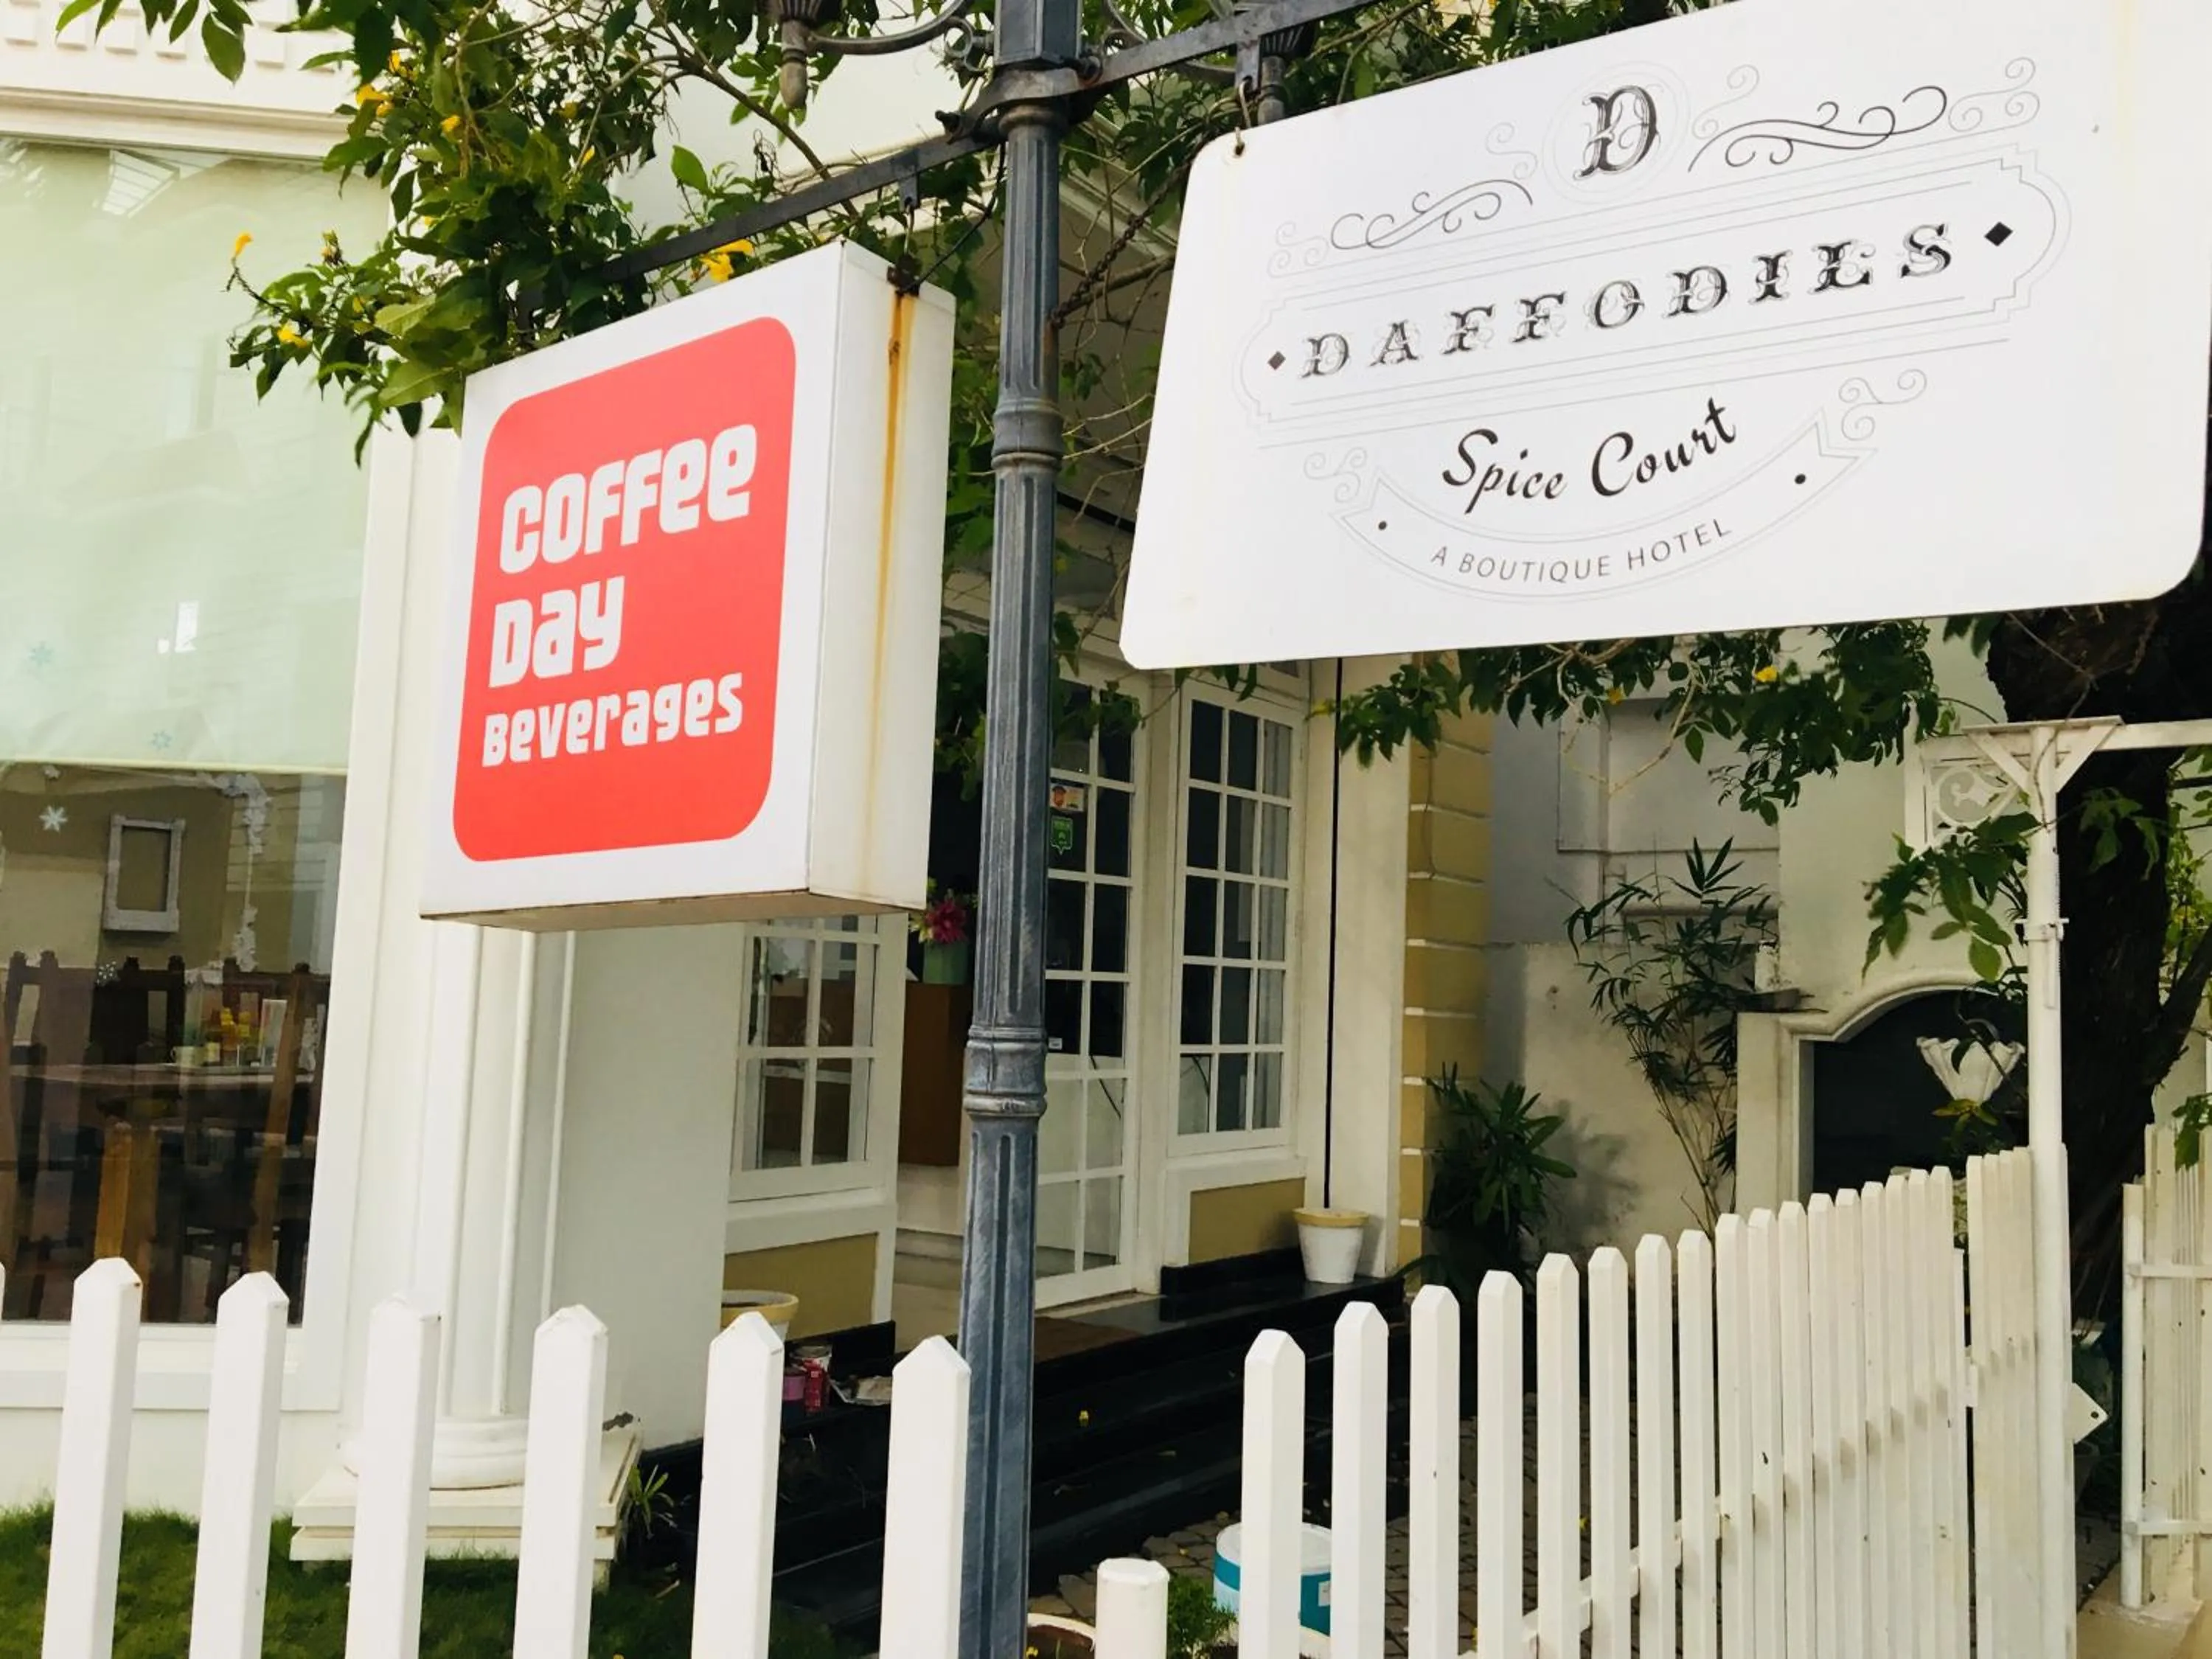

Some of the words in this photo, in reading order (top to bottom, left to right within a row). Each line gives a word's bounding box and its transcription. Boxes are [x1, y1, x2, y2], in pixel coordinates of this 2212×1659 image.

[1573, 85, 1660, 181] D
[1298, 223, 1954, 380] DAFFODILS
[1442, 428, 1567, 514] Spice
[1591, 397, 1736, 497] Court
[1431, 546, 1447, 566] A
[1458, 553, 1610, 583] BOUTIQUE
[1627, 518, 1731, 571] HOTEL
